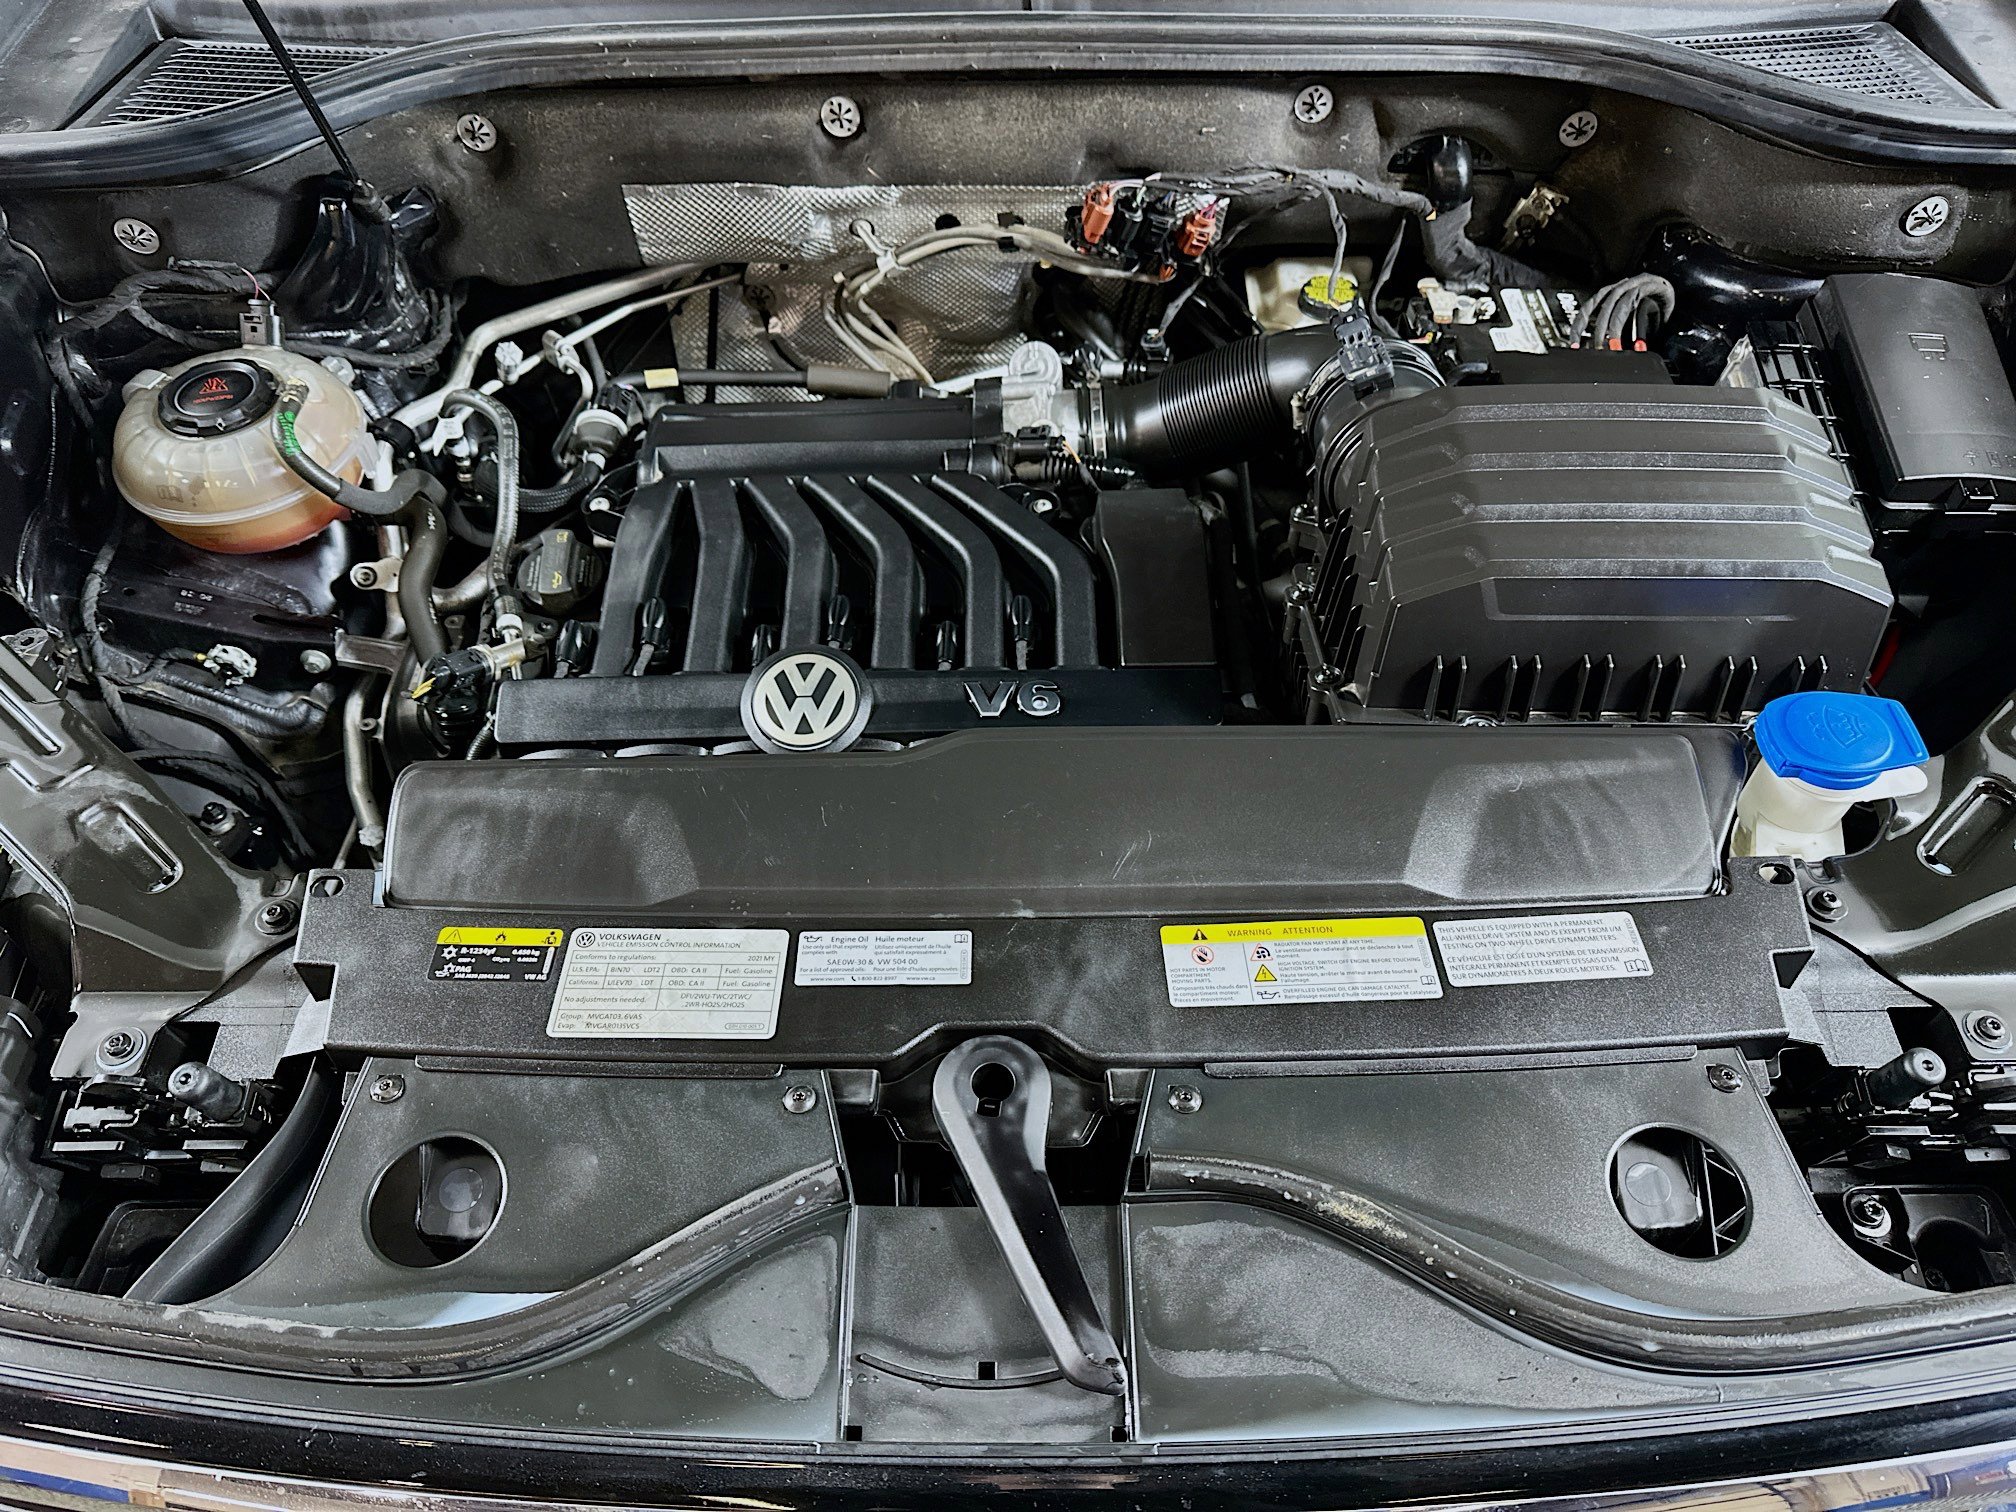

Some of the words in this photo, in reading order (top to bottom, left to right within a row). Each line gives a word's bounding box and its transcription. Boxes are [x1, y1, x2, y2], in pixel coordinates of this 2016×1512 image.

[963, 680, 1061, 717] V6
[1495, 923, 1531, 931] EQUIPPED
[1560, 919, 1604, 927] PERMANENT
[1227, 928, 1272, 937] WARNING
[1282, 926, 1333, 935] ATTENTION
[1441, 933, 1480, 942] ALL-WHEEL
[1533, 929, 1550, 937] AND
[1587, 926, 1608, 934] FROM
[599, 933, 662, 941] VOLKSWAGEN
[831, 936, 857, 944] Engine
[857, 935, 869, 943] Oil
[597, 941, 625, 949] VEHICLE
[692, 942, 741, 950] INFORMATION
[1443, 942, 1474, 950] TESTING
[1488, 939, 1534, 947] TWO-WHEEL
[1535, 937, 1557, 945] DRIVE
[459, 947, 497, 956] R-1234yf
[1458, 953, 1493, 962] VÉHICULE
[1494, 953, 1507, 961] EST
[1527, 951, 1546, 959] D'UN
[1547, 948, 1577, 957] SYSTÈME
[1588, 947, 1640, 955] TRANSMISSION
[617, 954, 657, 962] regulations:
[867, 958, 874, 966] &
[877, 958, 891, 966] VW
[892, 958, 907, 966] 504
[908, 958, 919, 966] 00
[455, 965, 473, 973] PAG
[1449, 962, 1488, 971] INTÉGRALE
[1489, 961, 1531, 969] PERMANENT
[724, 967, 741, 975] Fuel:
[743, 967, 773, 975] Gasoline
[1468, 969, 1528, 978] DYNAMOMÈTRES
[1534, 968, 1555, 976] DEUX
[1555, 966, 1580, 974] ROUES
[722, 980, 739, 988] Fuel:
[741, 980, 771, 988] Gasoline
[575, 996, 618, 1004] adjustments
[560, 1013, 584, 1021] Group:
[557, 1022, 576, 1030] Evap:
